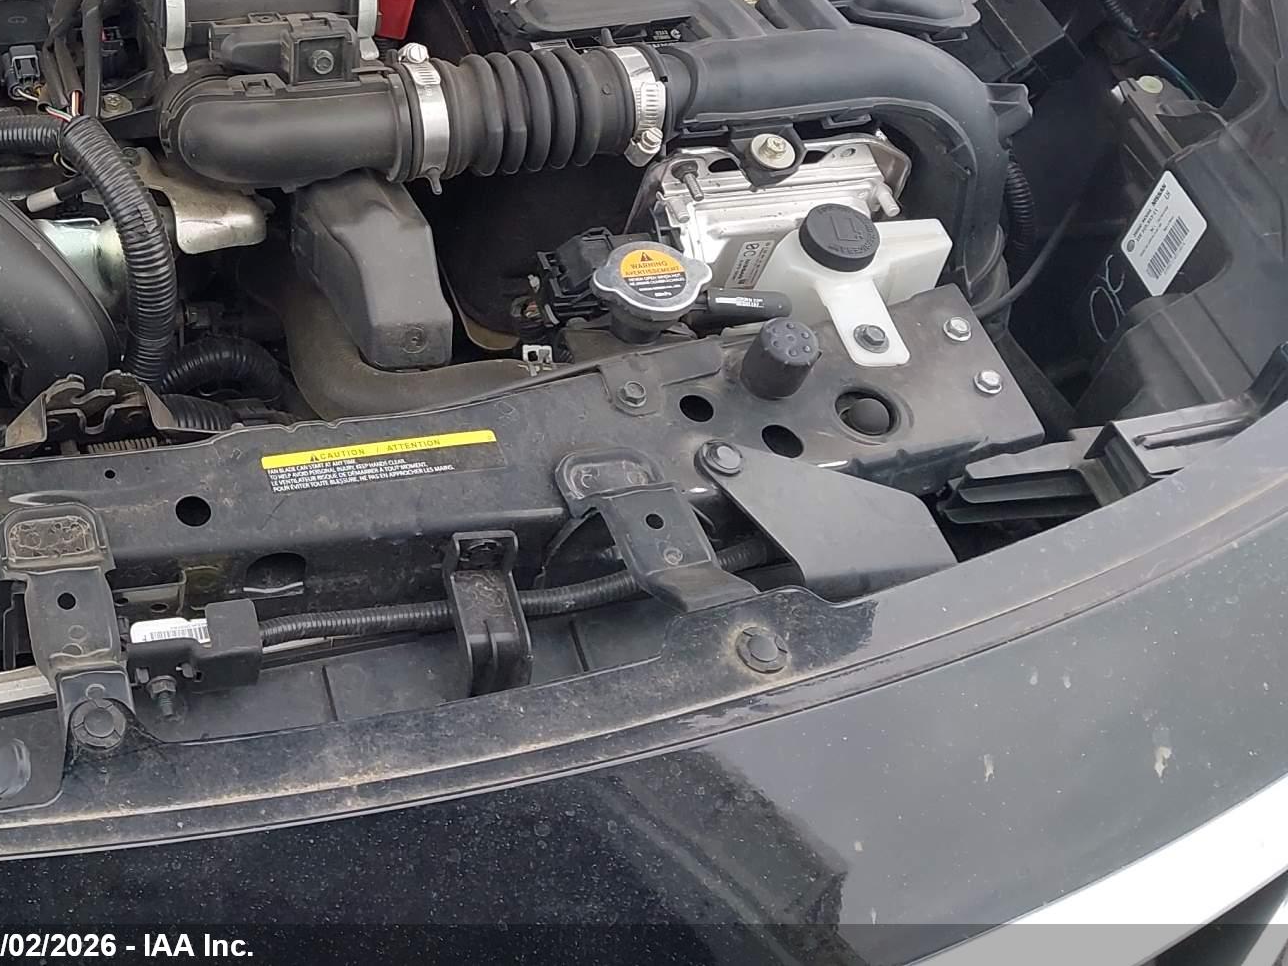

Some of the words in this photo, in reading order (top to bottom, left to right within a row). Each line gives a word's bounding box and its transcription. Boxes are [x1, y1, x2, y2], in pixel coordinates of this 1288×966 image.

[630, 260, 668, 270] WARNING
[320, 449, 365, 460] CAUTION
[386, 439, 441, 452] ATTENTION
